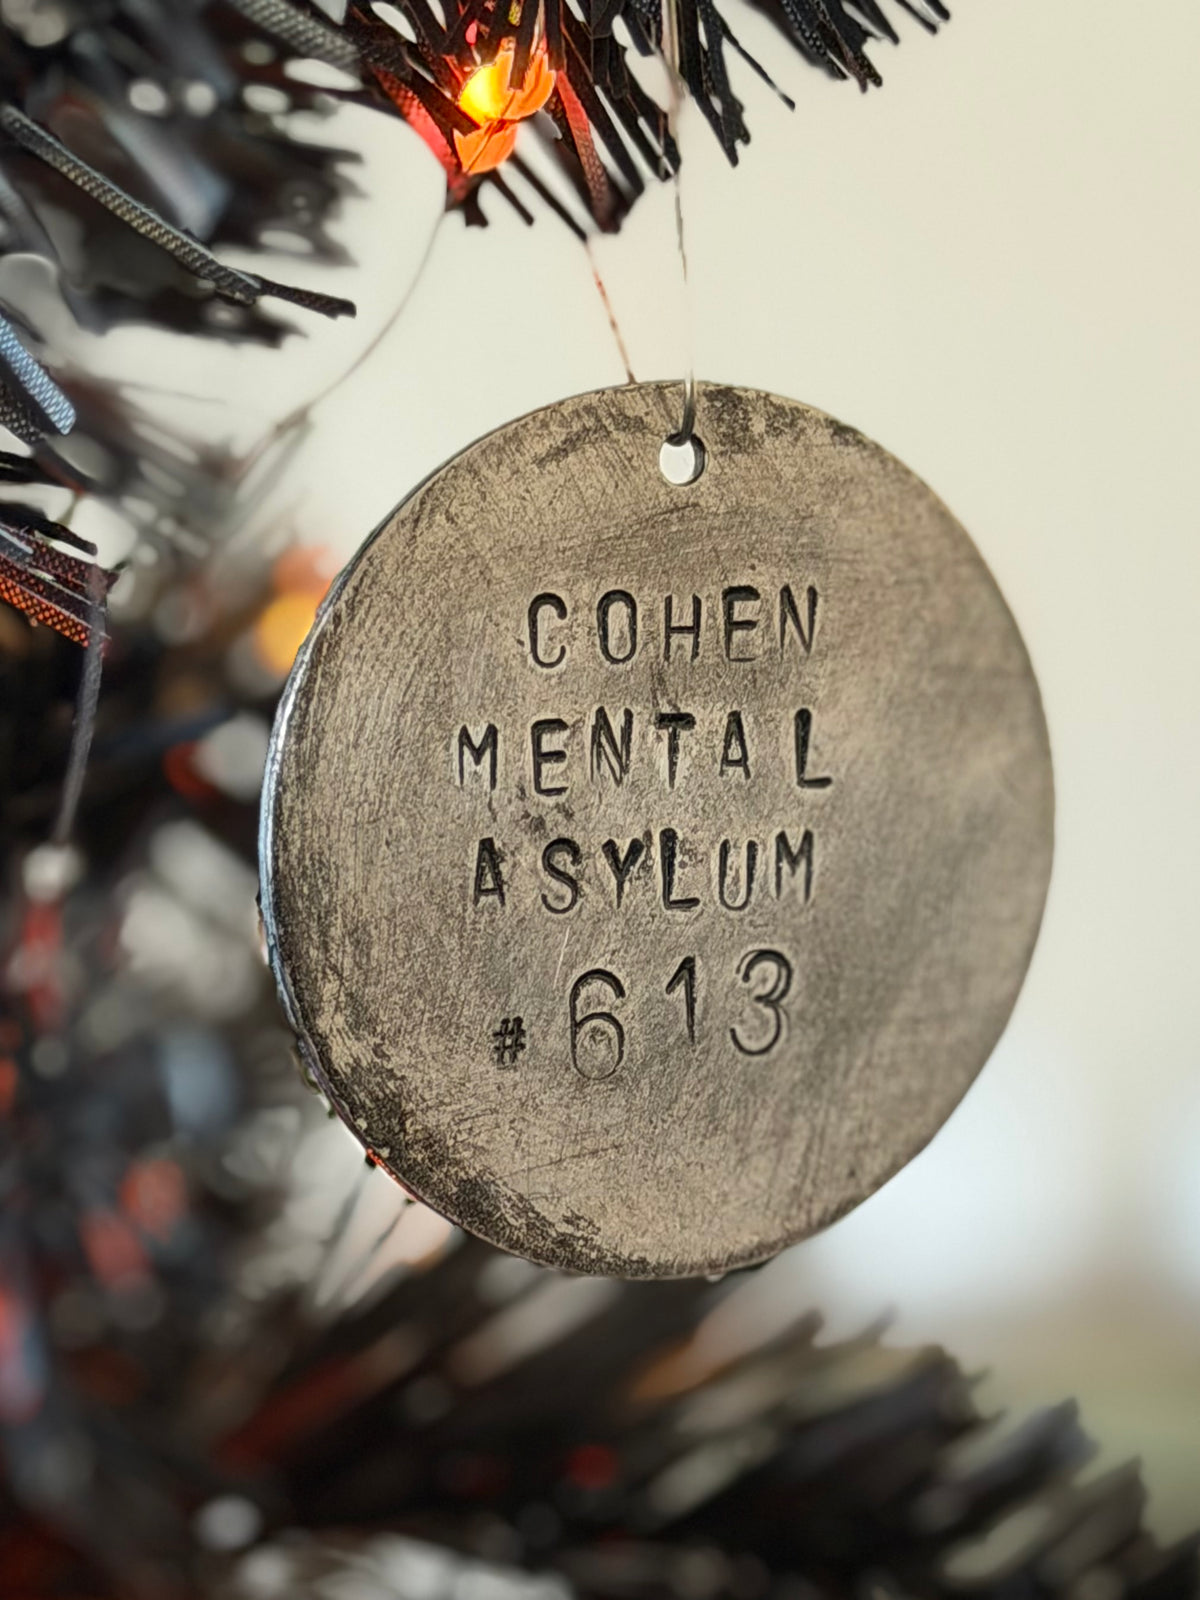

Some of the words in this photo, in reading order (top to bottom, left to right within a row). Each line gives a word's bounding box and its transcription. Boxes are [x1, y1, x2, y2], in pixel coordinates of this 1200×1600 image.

[527, 583, 819, 669] COHEN
[457, 705, 834, 797] MENTAL
[473, 827, 814, 915] ASYLUM
